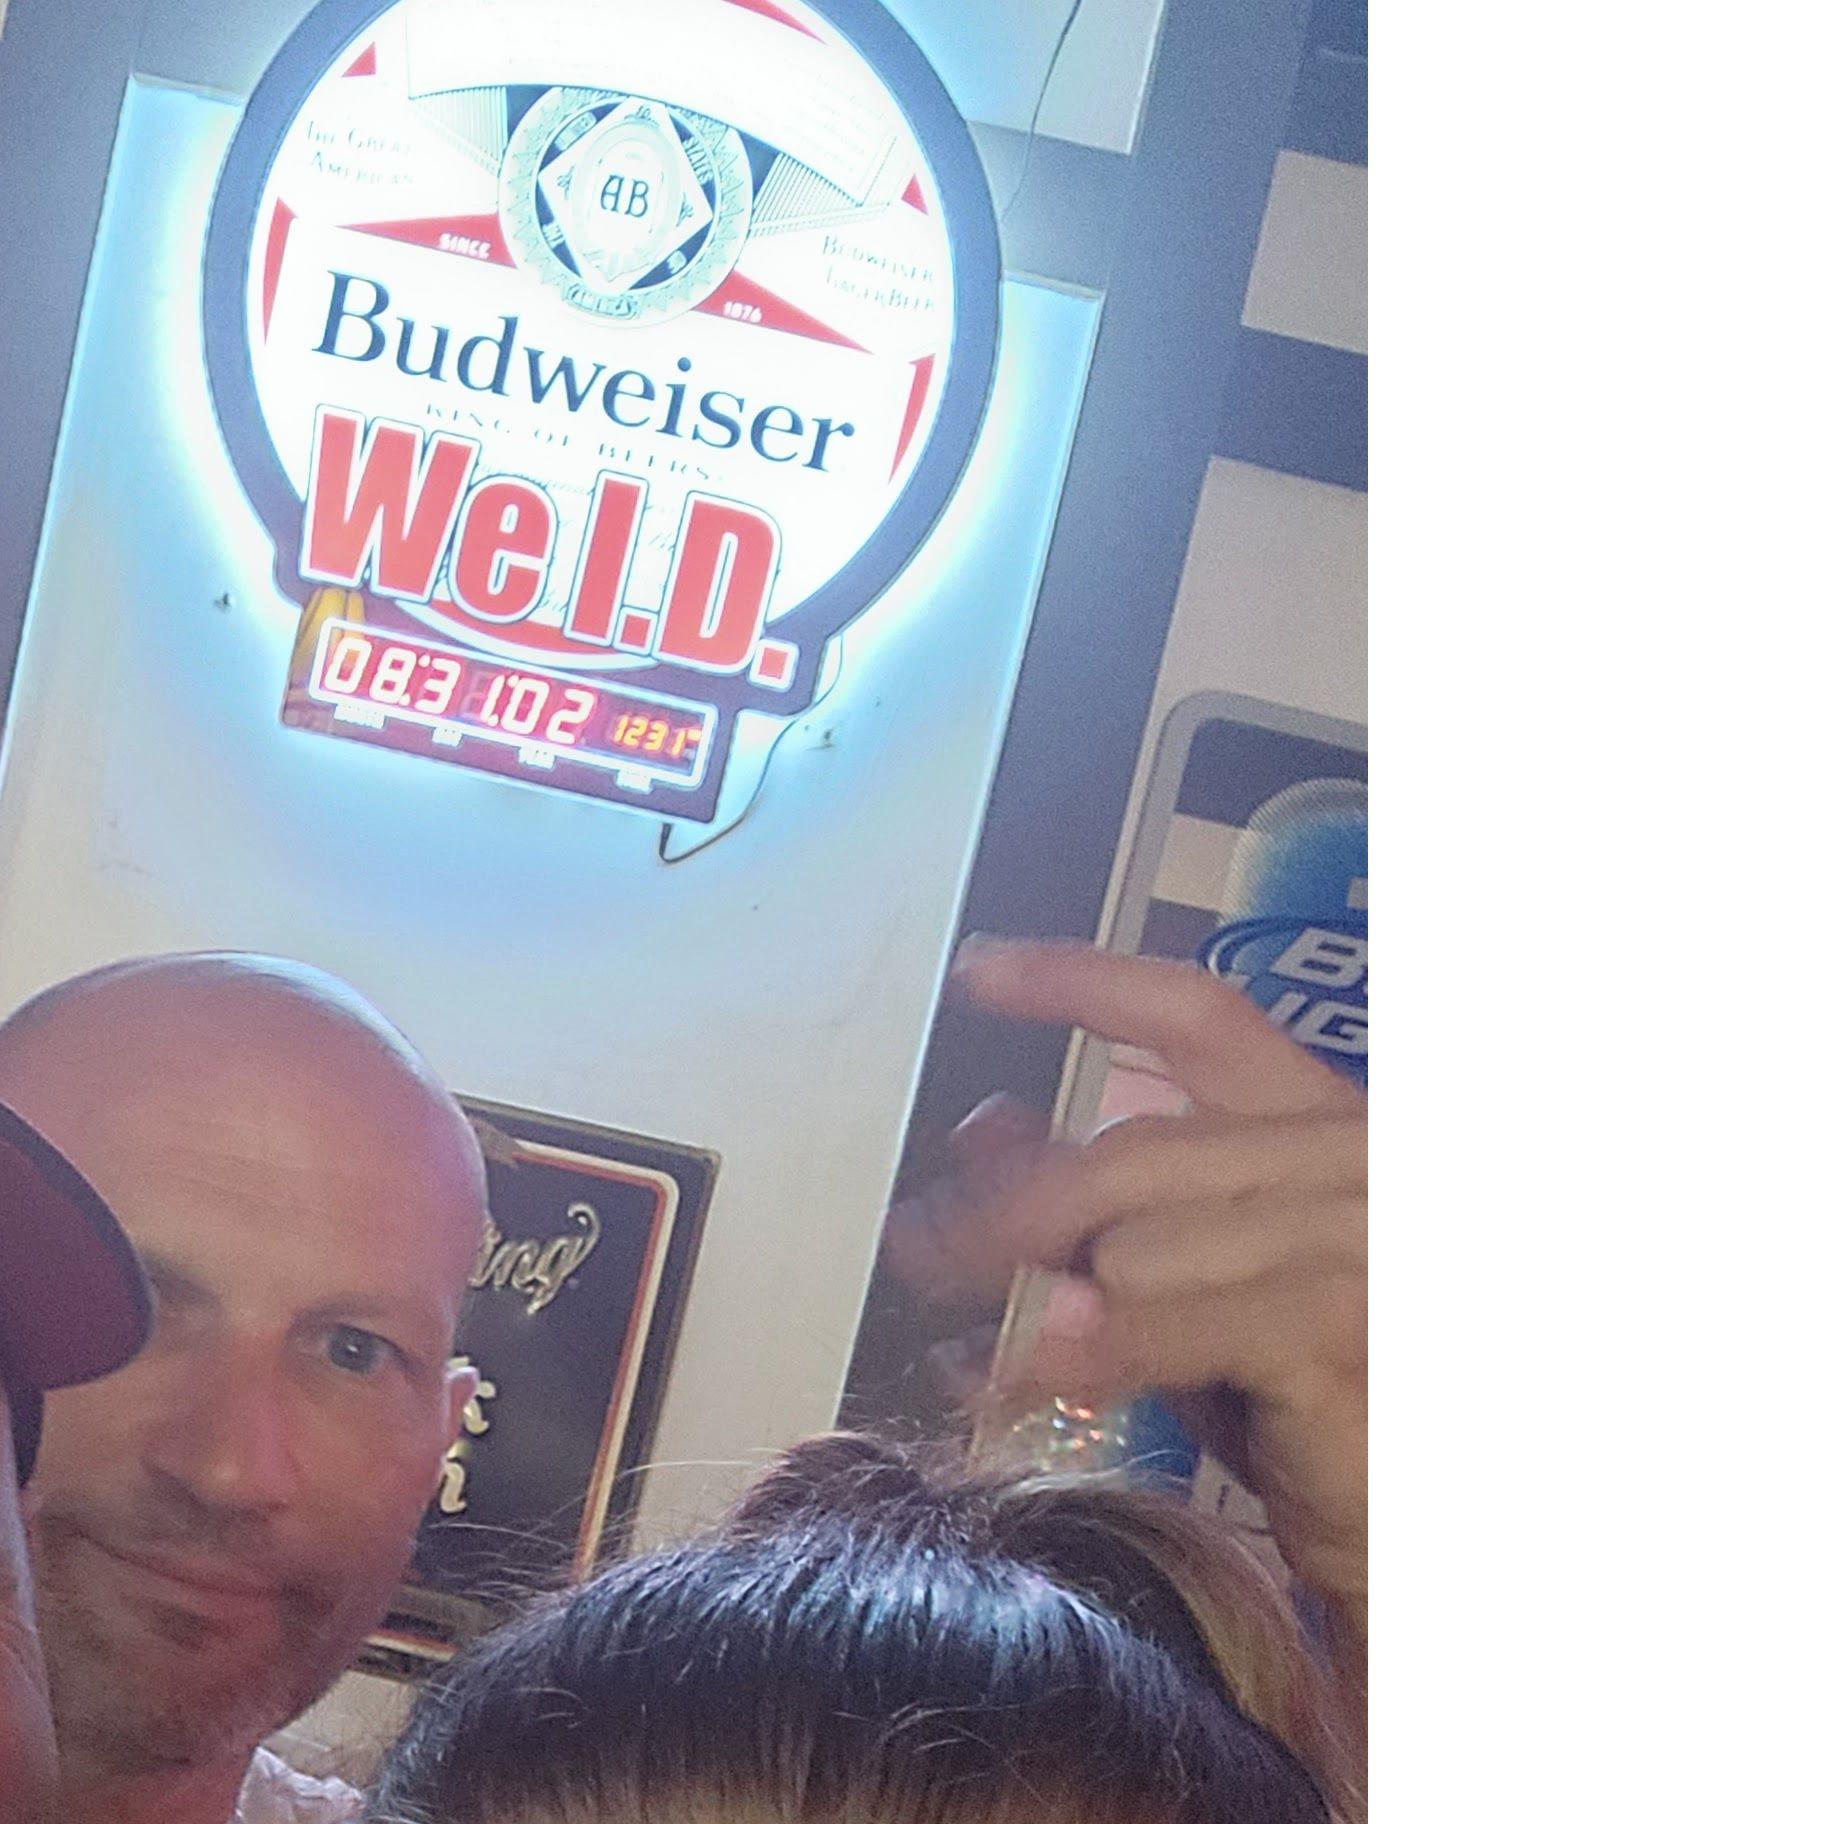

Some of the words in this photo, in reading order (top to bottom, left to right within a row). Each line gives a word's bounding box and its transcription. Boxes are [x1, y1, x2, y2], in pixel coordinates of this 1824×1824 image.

[438, 232, 492, 260] SINCE
[599, 174, 650, 219] AB
[310, 268, 857, 474] Budweiser
[303, 406, 557, 622] We
